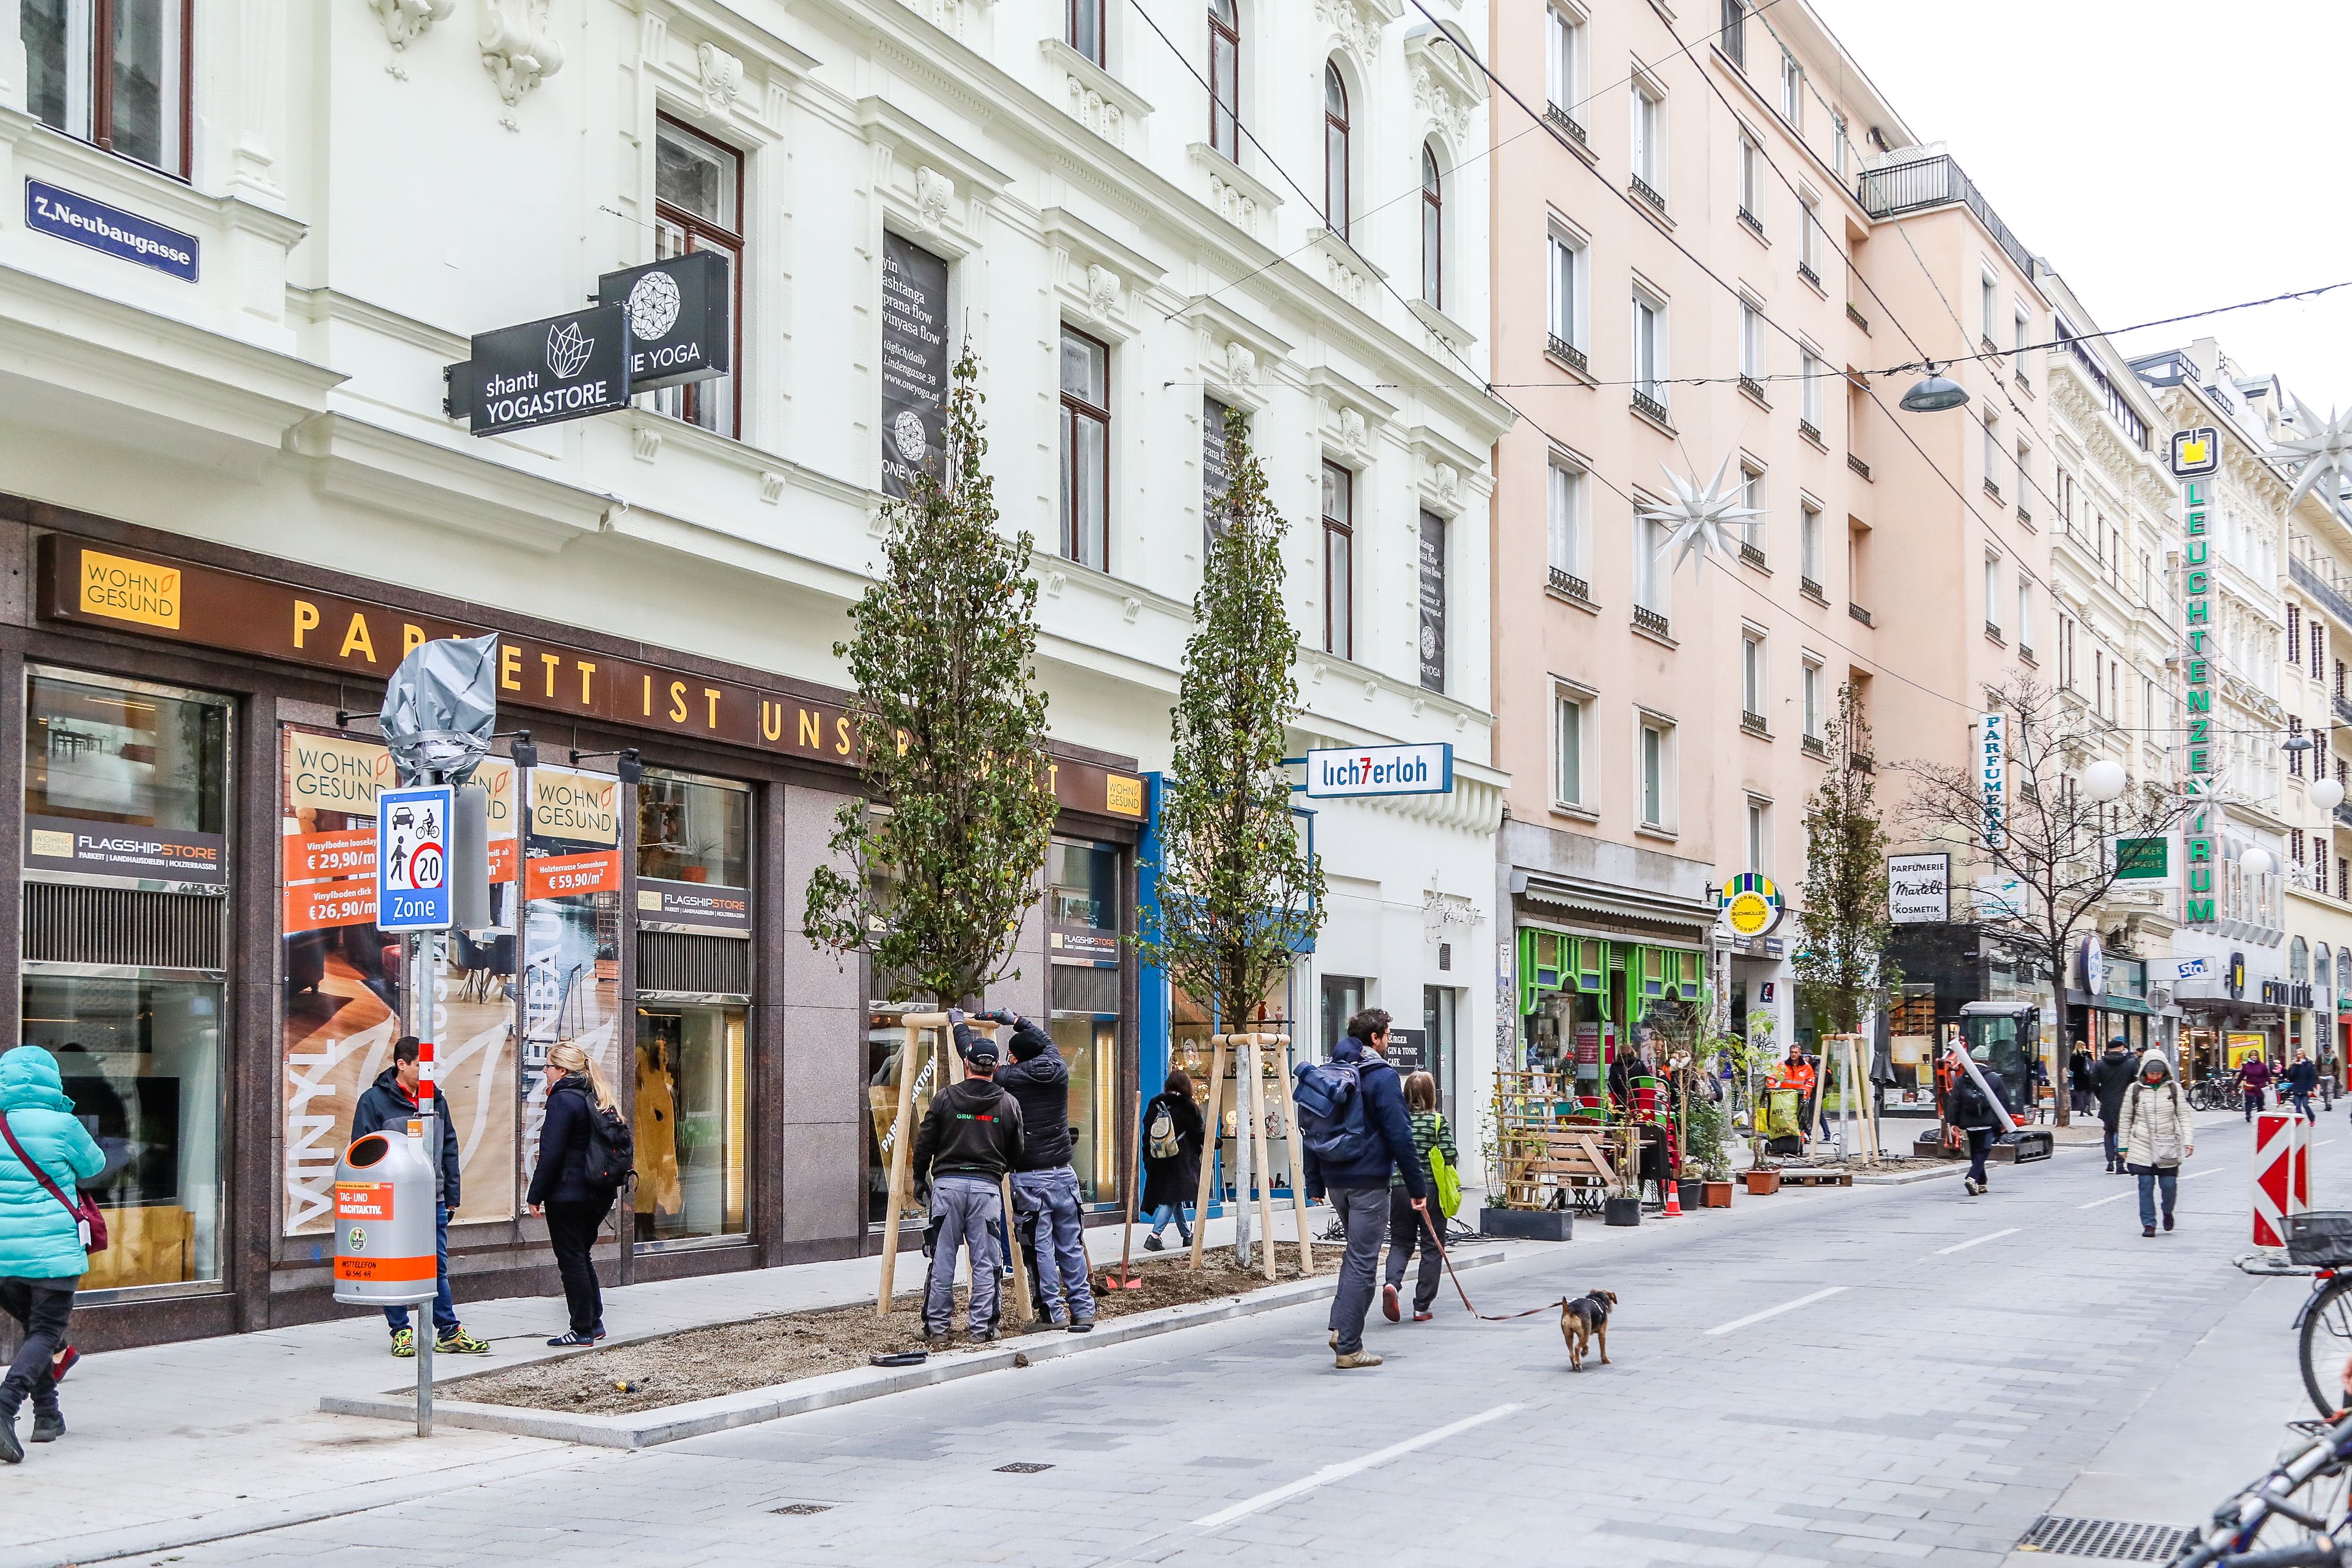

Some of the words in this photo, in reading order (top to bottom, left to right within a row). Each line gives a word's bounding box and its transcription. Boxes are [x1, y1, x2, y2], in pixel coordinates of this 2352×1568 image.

[883, 256, 898, 273] yin
[883, 276, 925, 305] ashtanga
[883, 293, 910, 315] prana
[912, 304, 932, 324] flow
[883, 310, 918, 336] vinyasa
[920, 325, 940, 345] flow
[649, 342, 701, 369] YOGA
[883, 339, 927, 367] täglich/daily
[883, 354, 927, 381] Lindengasse
[927, 373, 936, 385] 38
[883, 372, 940, 402] www.oneyoga.at
[486, 380, 607, 424] YOGASTORE
[882, 459, 906, 479] ONE
[88, 563, 158, 594] WOHN
[88, 585, 173, 616] GESUND
[295, 600, 596, 705] PARETT
[643, 674, 721, 723] IST
[1426, 664, 1441, 678] YOGA
[299, 748, 372, 778] WOHN
[539, 783, 599, 810] WOHN
[1109, 782, 1134, 796] WOHN
[1109, 794, 1139, 809] GESUND
[537, 805, 612, 832] GESUND
[35, 835, 64, 844] WOHN
[35, 842, 71, 853] GESUND
[79, 835, 217, 860] FLAGSHIPSTORE
[307, 840, 349, 852] Vinylboden
[308, 854, 316, 870] €
[319, 851, 376, 870] 29,90/m
[502, 847, 509, 856] ab
[78, 851, 105, 861] PARKETT
[109, 855, 165, 866] LANDHAUSDIELEN
[169, 860, 217, 871] HOLZTERRASSEN
[419, 857, 439, 882] 20
[540, 864, 576, 874] Holzterrasse
[577, 860, 608, 871] Sonnenbaum
[549, 876, 556, 890] €
[313, 891, 356, 901] Vinylboden
[358, 887, 372, 895] click
[664, 894, 746, 911] FLAGSHIPSTORE
[1731, 895, 1766, 911] REFORMHAUS
[309, 905, 316, 920] €
[393, 897, 436, 918] Zone
[1896, 905, 1940, 914] KOSMETIK
[1731, 917, 1766, 932] REFORMHAUS
[1064, 934, 1115, 947] FLAGSHIPSTORE
[1388, 1047, 1398, 1055] GIN
[1398, 1047, 1402, 1055] &
[1402, 1047, 1418, 1055] TONIC
[288, 1038, 336, 1233] VINYL
[339, 1192, 352, 1202] TAG-
[353, 1192, 368, 1202] UND
[340, 1204, 383, 1215] NACHTAKTIV.
[342, 1260, 376, 1269] MISTTELEFON
